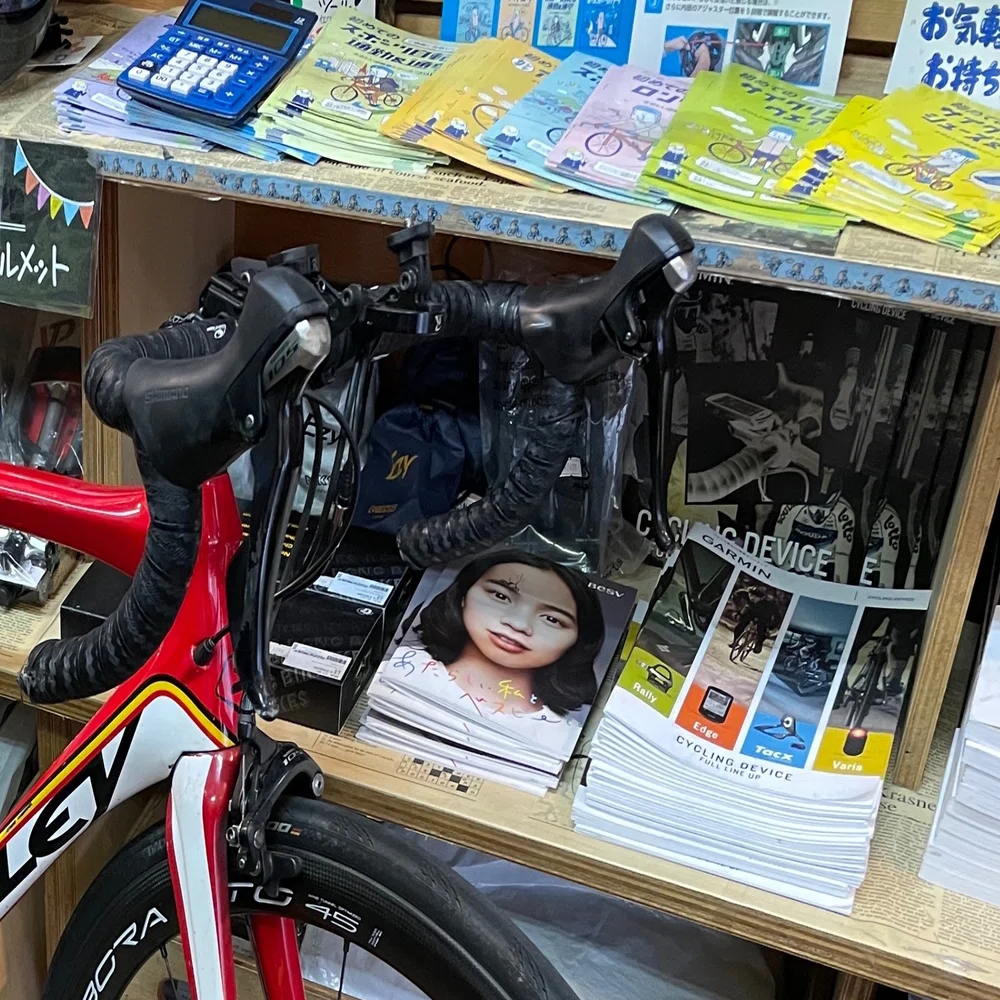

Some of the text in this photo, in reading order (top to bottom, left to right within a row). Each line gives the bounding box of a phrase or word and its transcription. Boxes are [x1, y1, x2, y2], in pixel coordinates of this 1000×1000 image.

[701, 534, 772, 581] GARMIN
[742, 532, 834, 578] DEVICE
[632, 681, 658, 705] Rally
[692, 721, 720, 741] Edge
[674, 735, 793, 783] CYCLING DEVICE
[754, 744, 796, 762] Tacx
[698, 756, 762, 781] FULL LINE UP
[832, 760, 864, 773] Varia
[305, 903, 360, 933] 45
